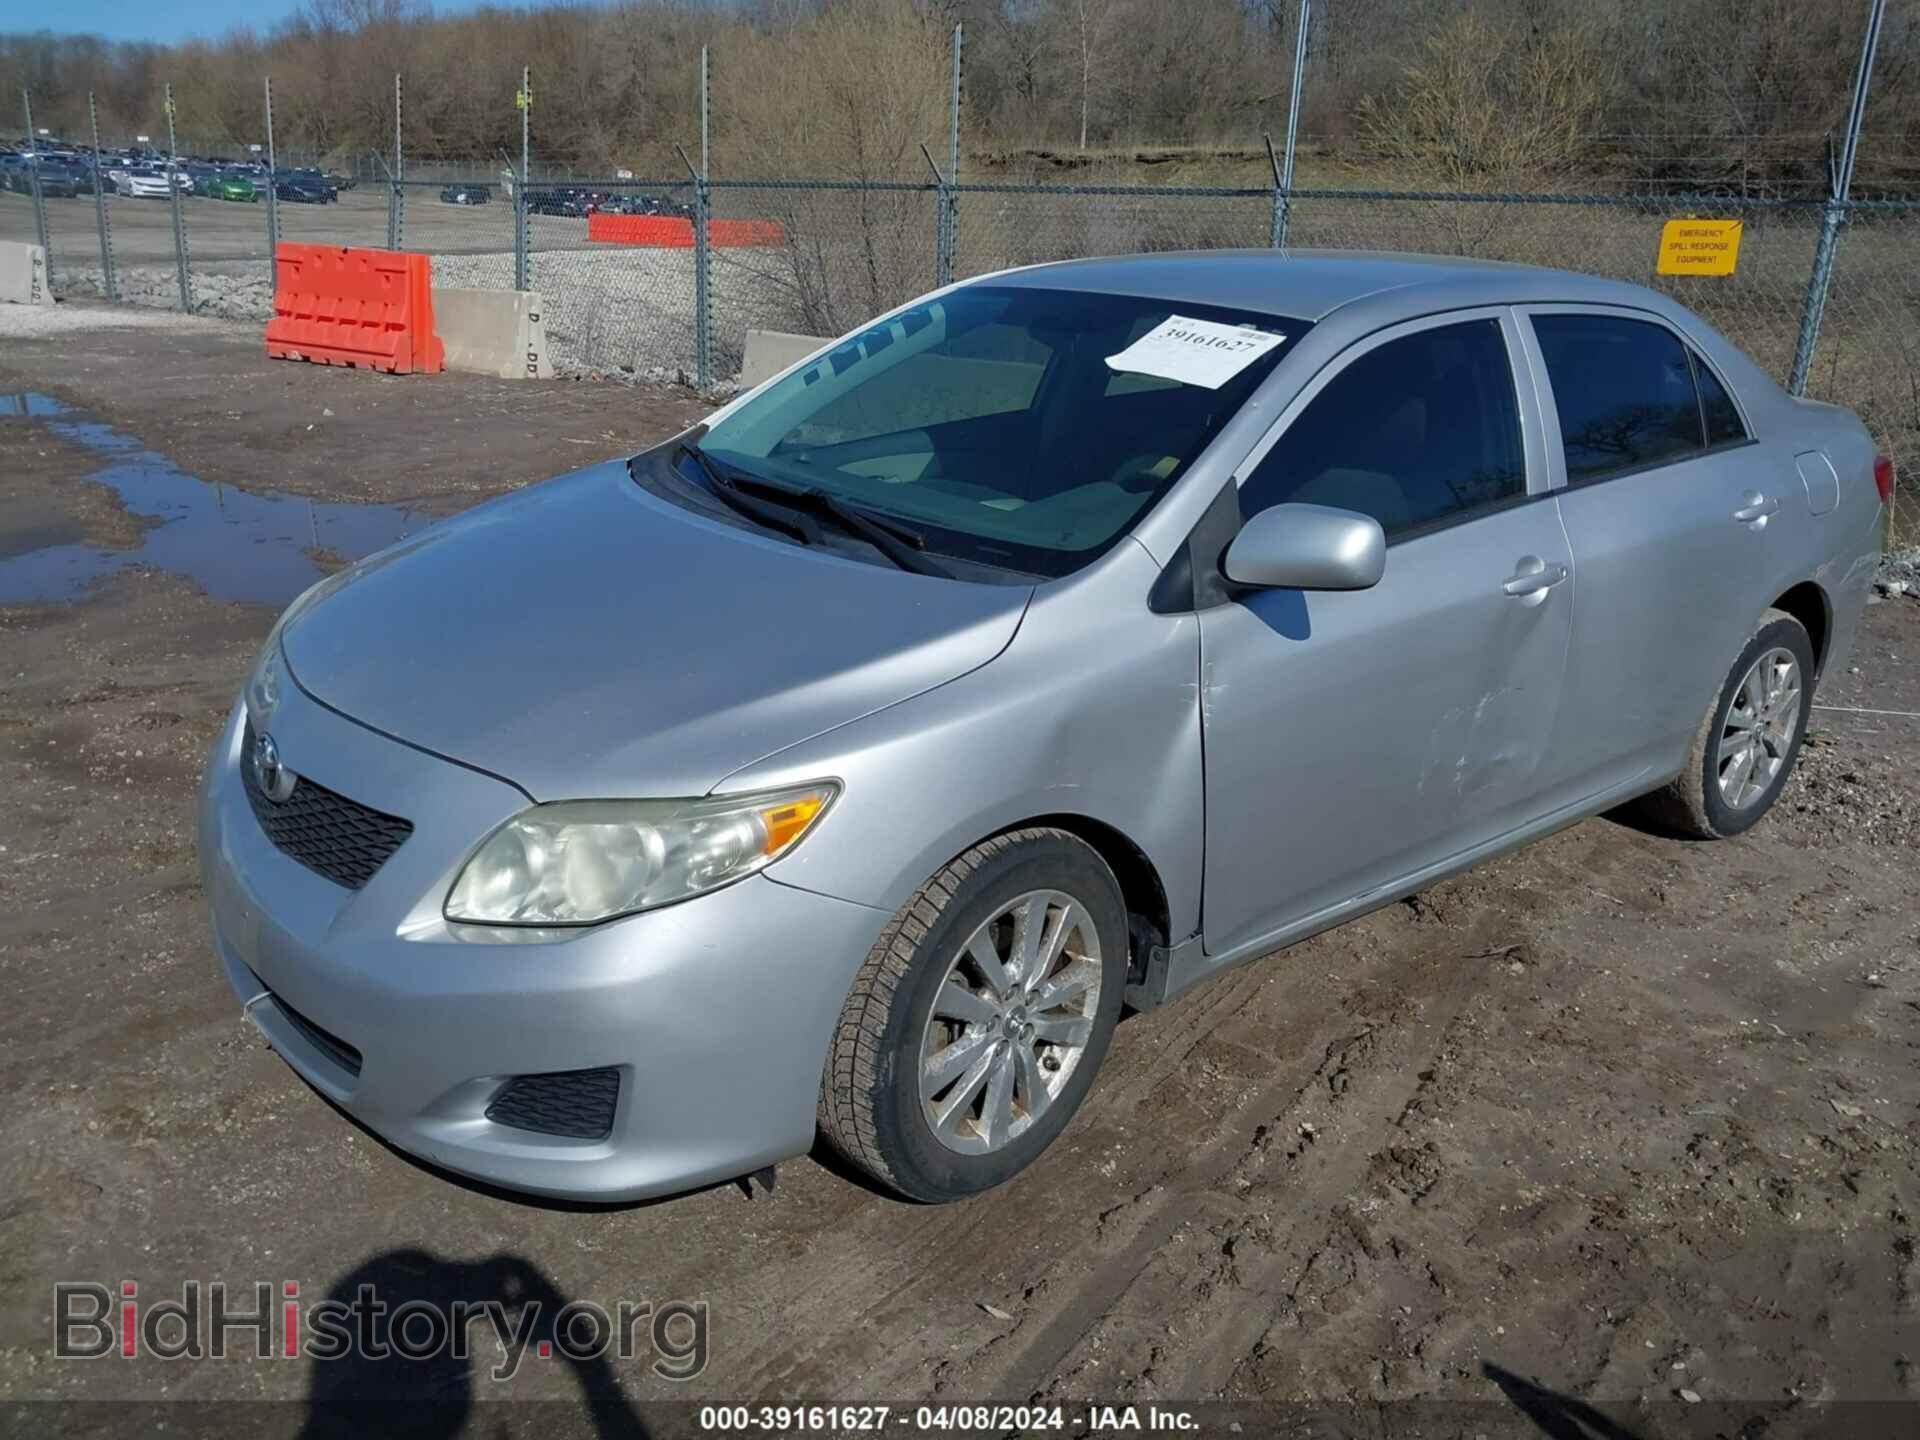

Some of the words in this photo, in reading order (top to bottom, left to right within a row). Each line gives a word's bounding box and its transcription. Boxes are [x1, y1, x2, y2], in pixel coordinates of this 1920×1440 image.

[1679, 229, 1723, 237] EMERGENCY
[1670, 242, 1688, 250] SPILL
[1691, 242, 1728, 250] RESPONSE
[1676, 256, 1717, 264] EQUIPMENT
[1167, 328, 1256, 352] 39161627
